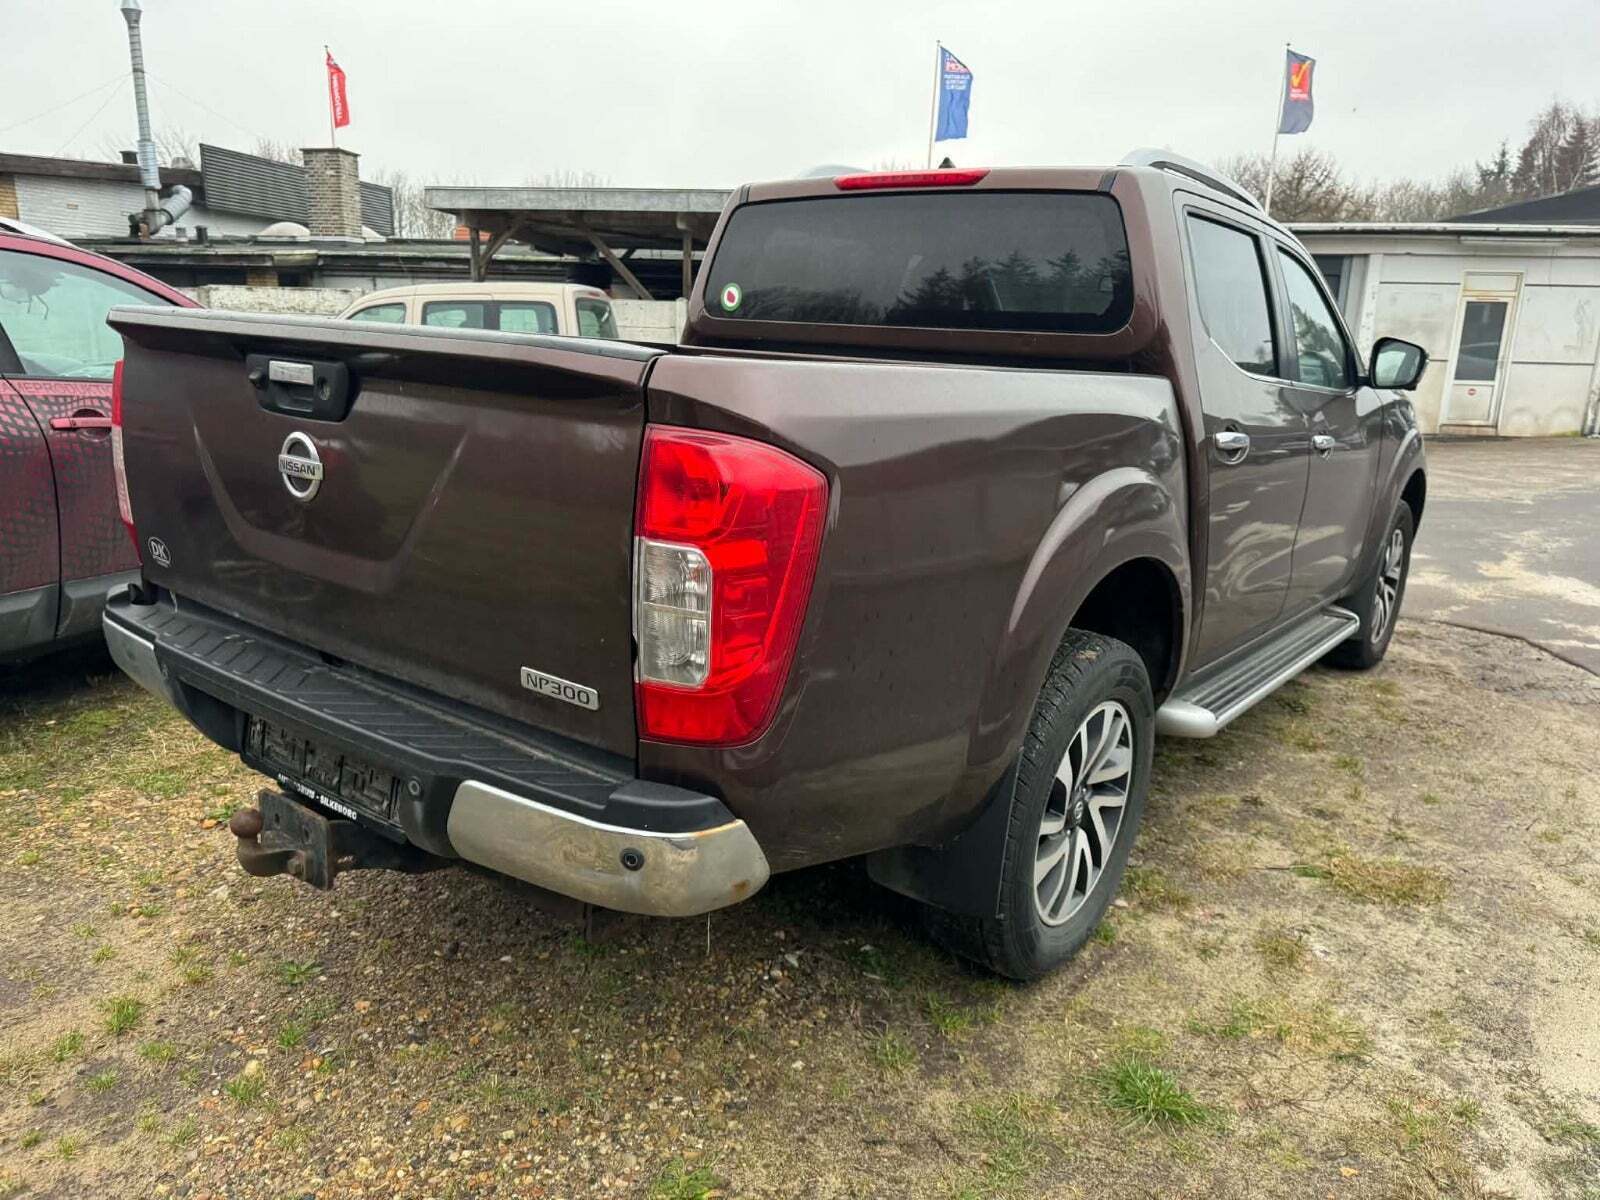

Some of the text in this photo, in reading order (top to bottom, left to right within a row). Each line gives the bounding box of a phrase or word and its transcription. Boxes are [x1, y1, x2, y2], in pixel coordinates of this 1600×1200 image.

[280, 459, 316, 476] NISSAN
[151, 540, 168, 560] DK
[526, 673, 590, 705] NP300
